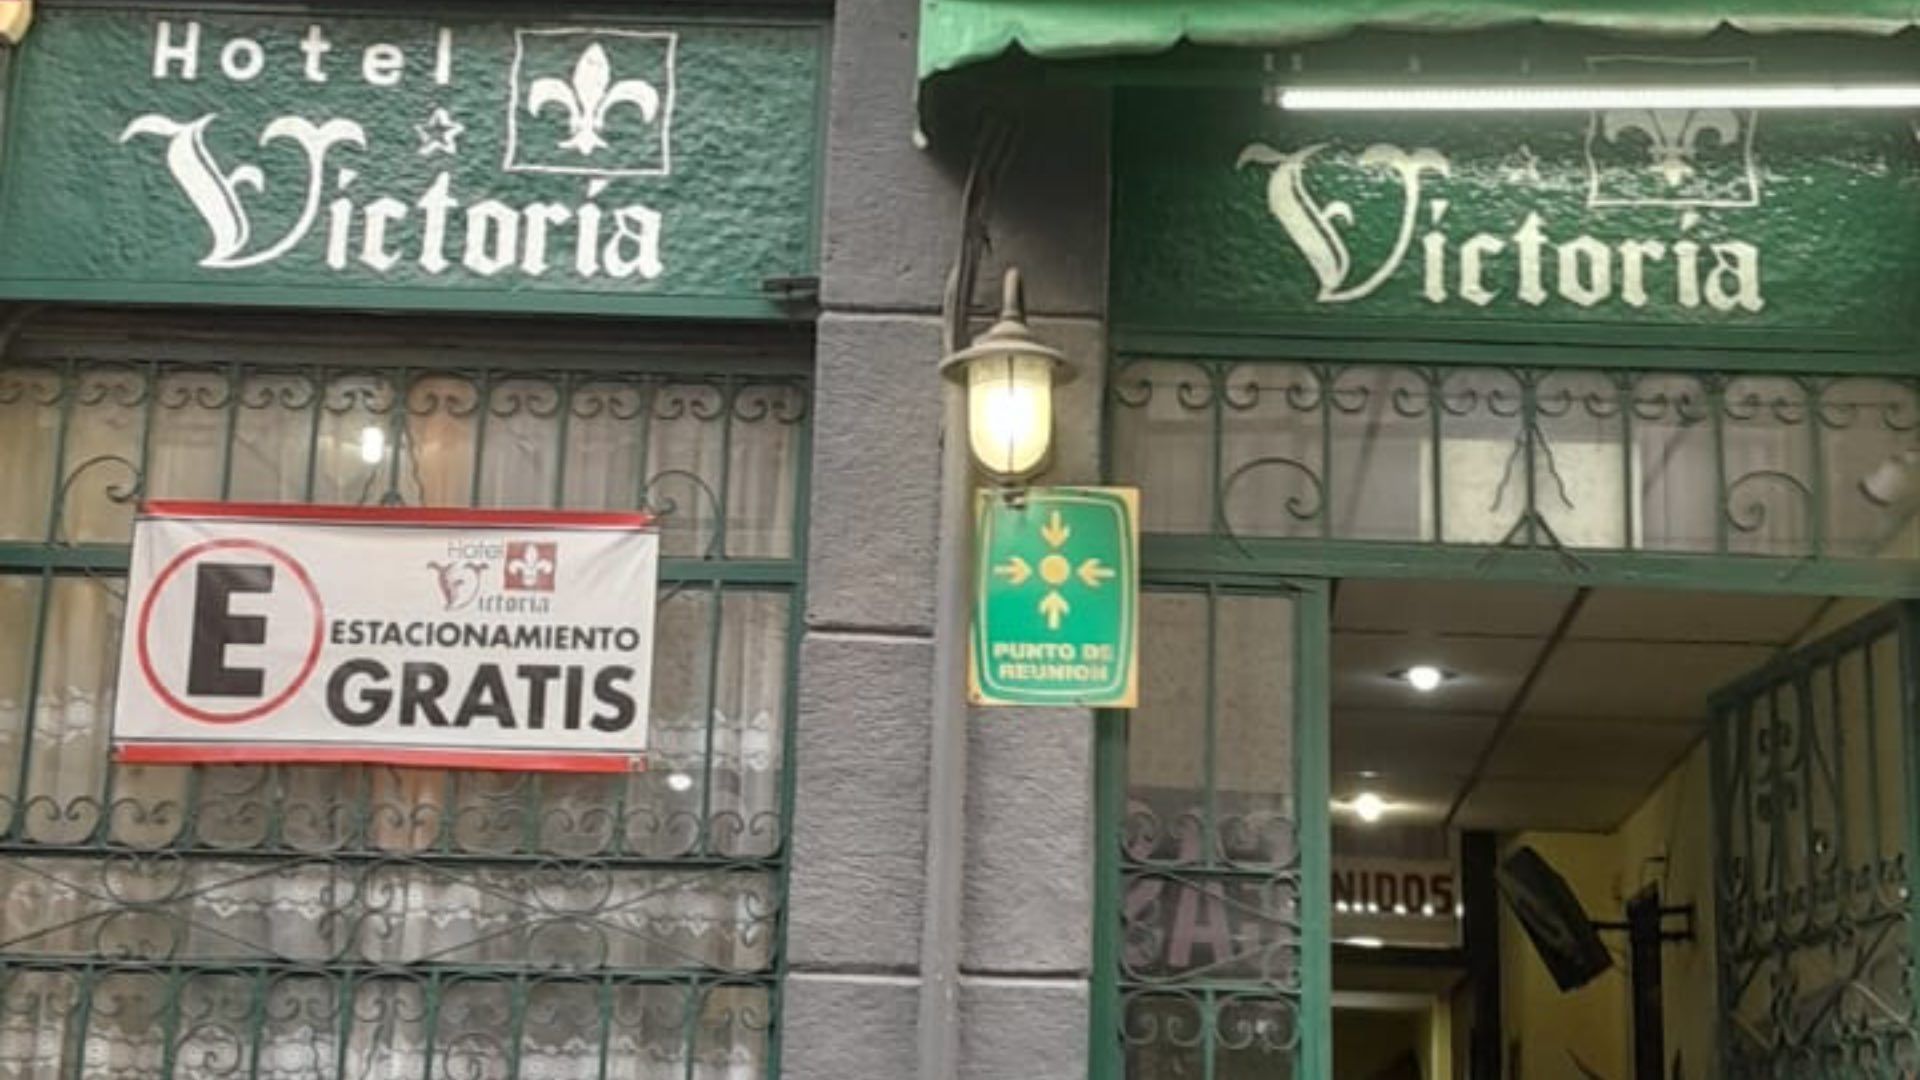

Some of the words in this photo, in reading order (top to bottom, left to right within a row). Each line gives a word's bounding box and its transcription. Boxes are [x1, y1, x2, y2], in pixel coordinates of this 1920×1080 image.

[152, 21, 453, 87] Hotel
[120, 113, 664, 279] Victoria
[1237, 142, 1765, 312] Victoria
[447, 539, 504, 560] Hotel
[187, 562, 275, 698] E
[330, 621, 640, 652] ESTACIONAMIENTO
[993, 641, 1076, 661] PUNTO
[1082, 642, 1113, 662] DE
[326, 658, 637, 733] GRATIS
